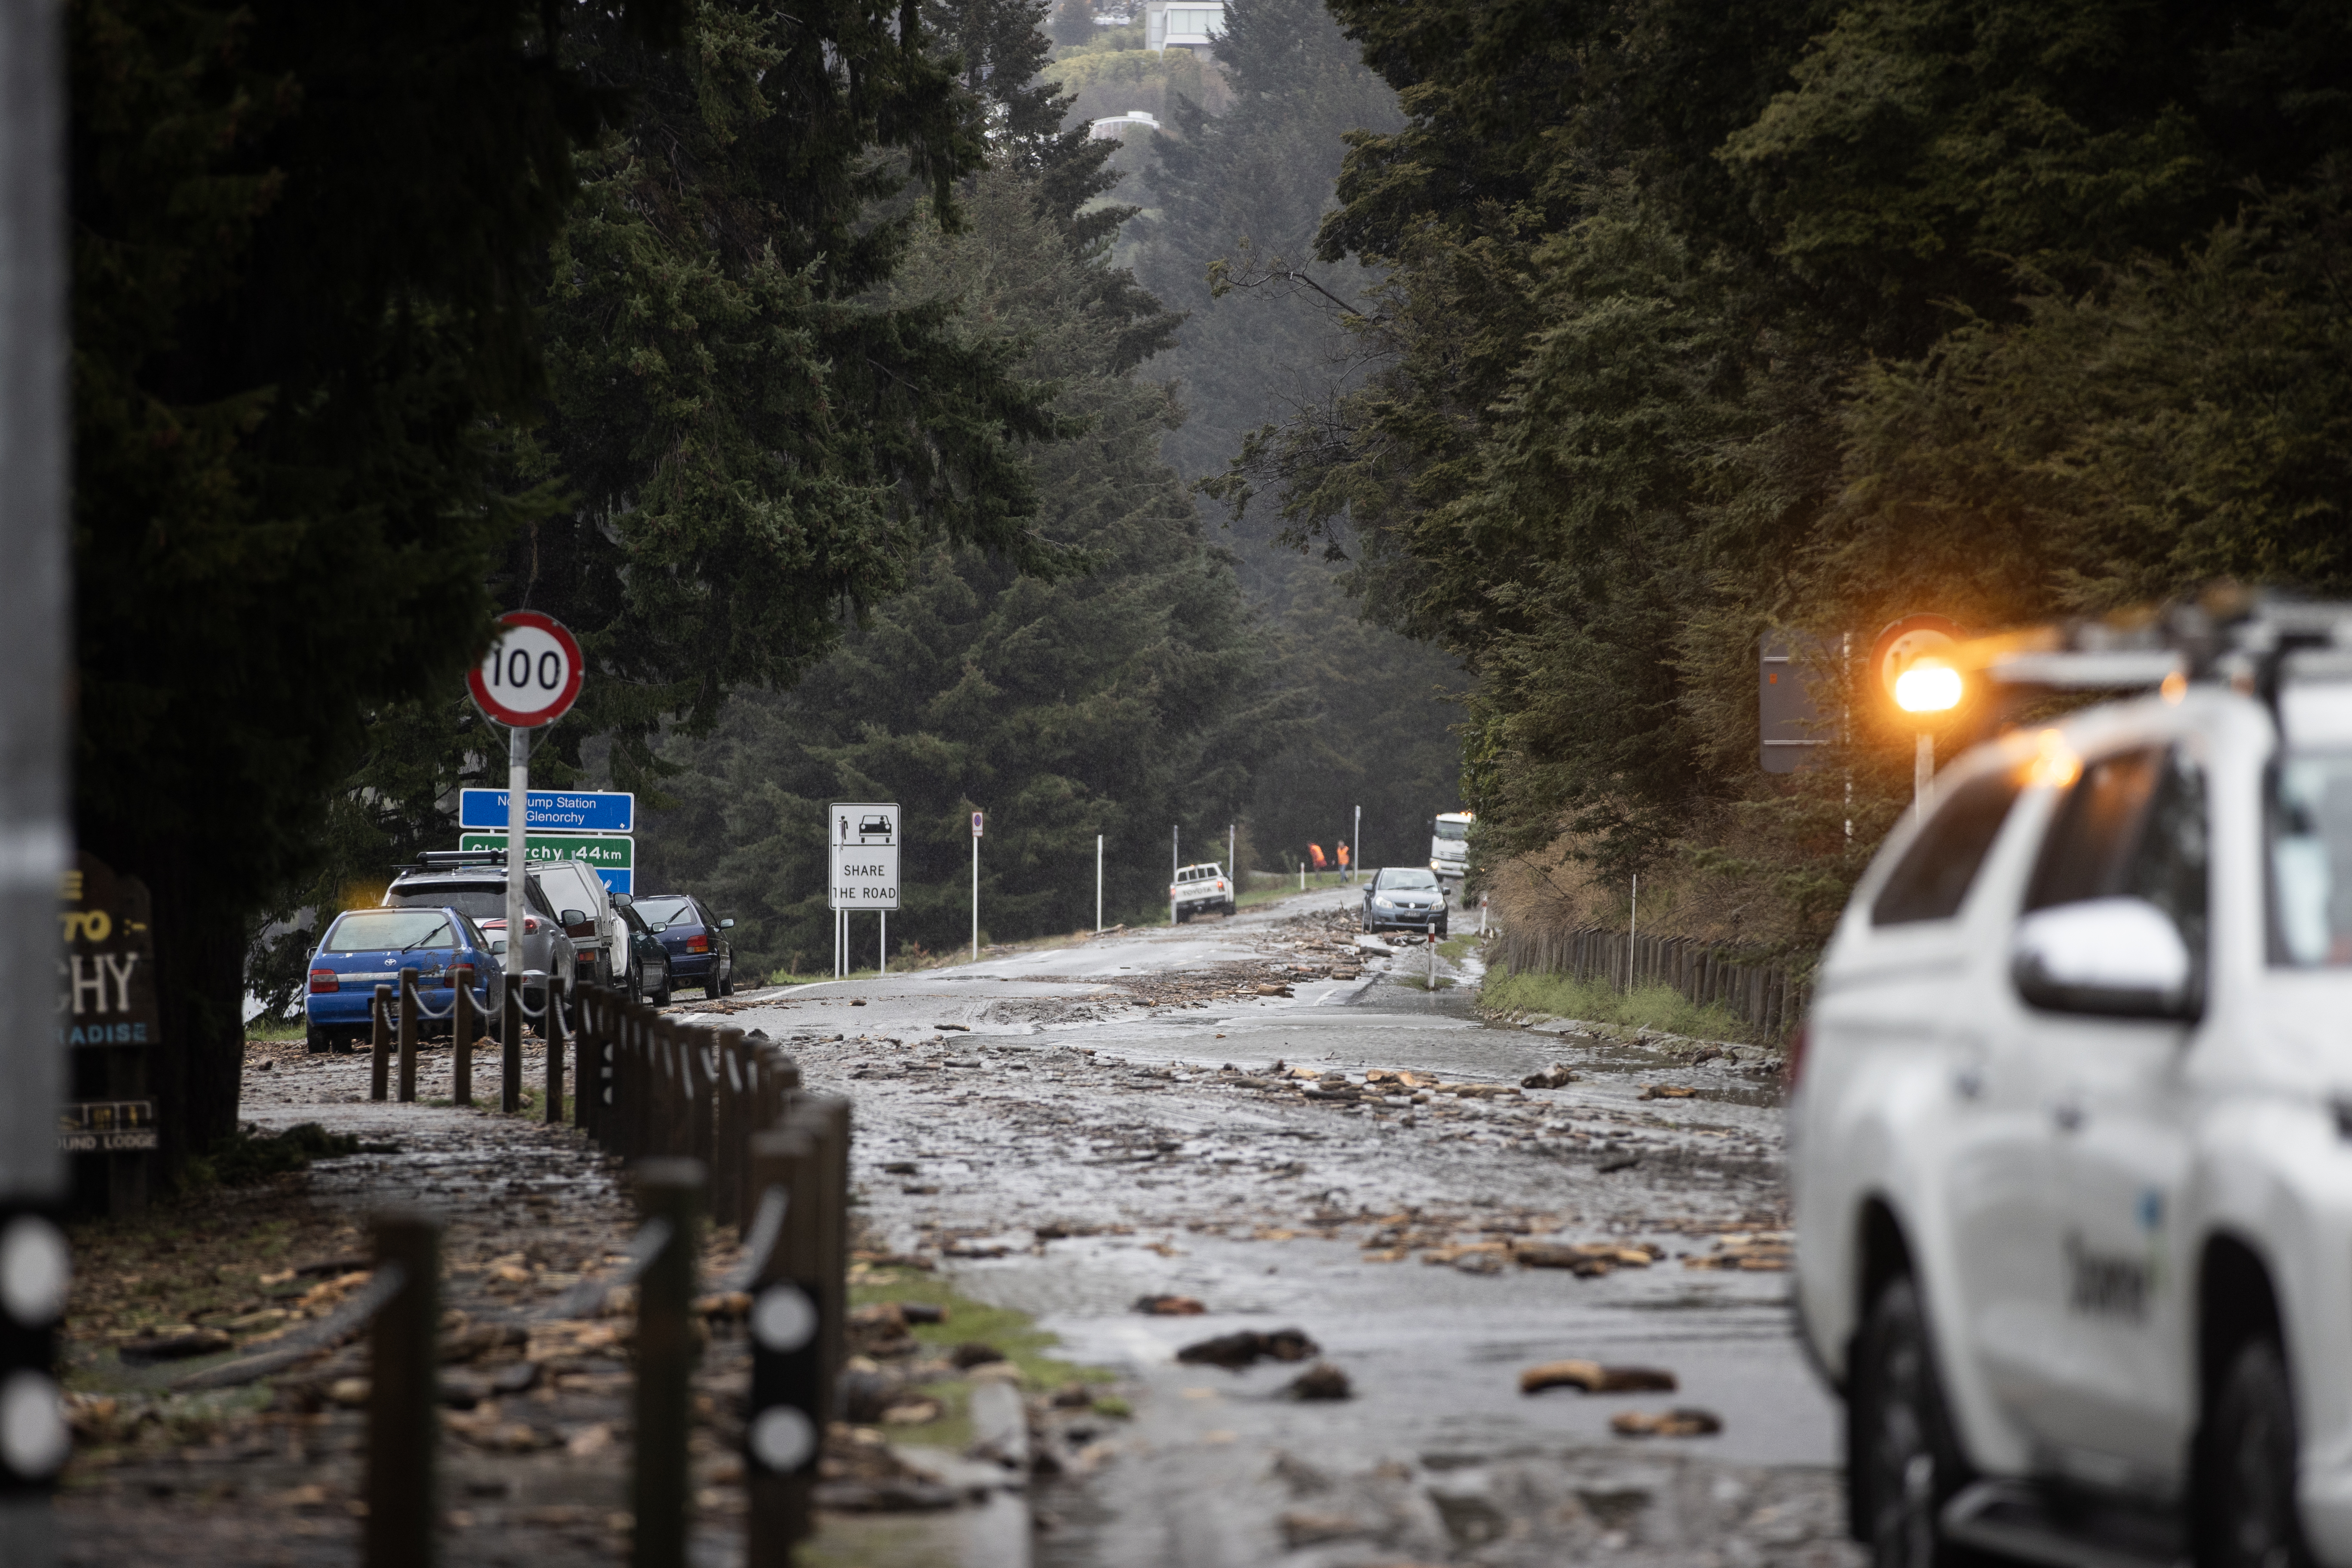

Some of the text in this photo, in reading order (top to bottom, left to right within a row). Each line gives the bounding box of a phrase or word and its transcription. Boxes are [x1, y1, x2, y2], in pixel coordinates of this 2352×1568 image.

[493, 647, 561, 690] 100
[557, 797, 596, 808] Station
[525, 811, 585, 825] Glenorchy
[844, 865, 885, 876] SHARE
[863, 887, 896, 898] ROAD
[1182, 887, 1212, 896] TOYOTA
[103, 1133, 158, 1151] LODGE
